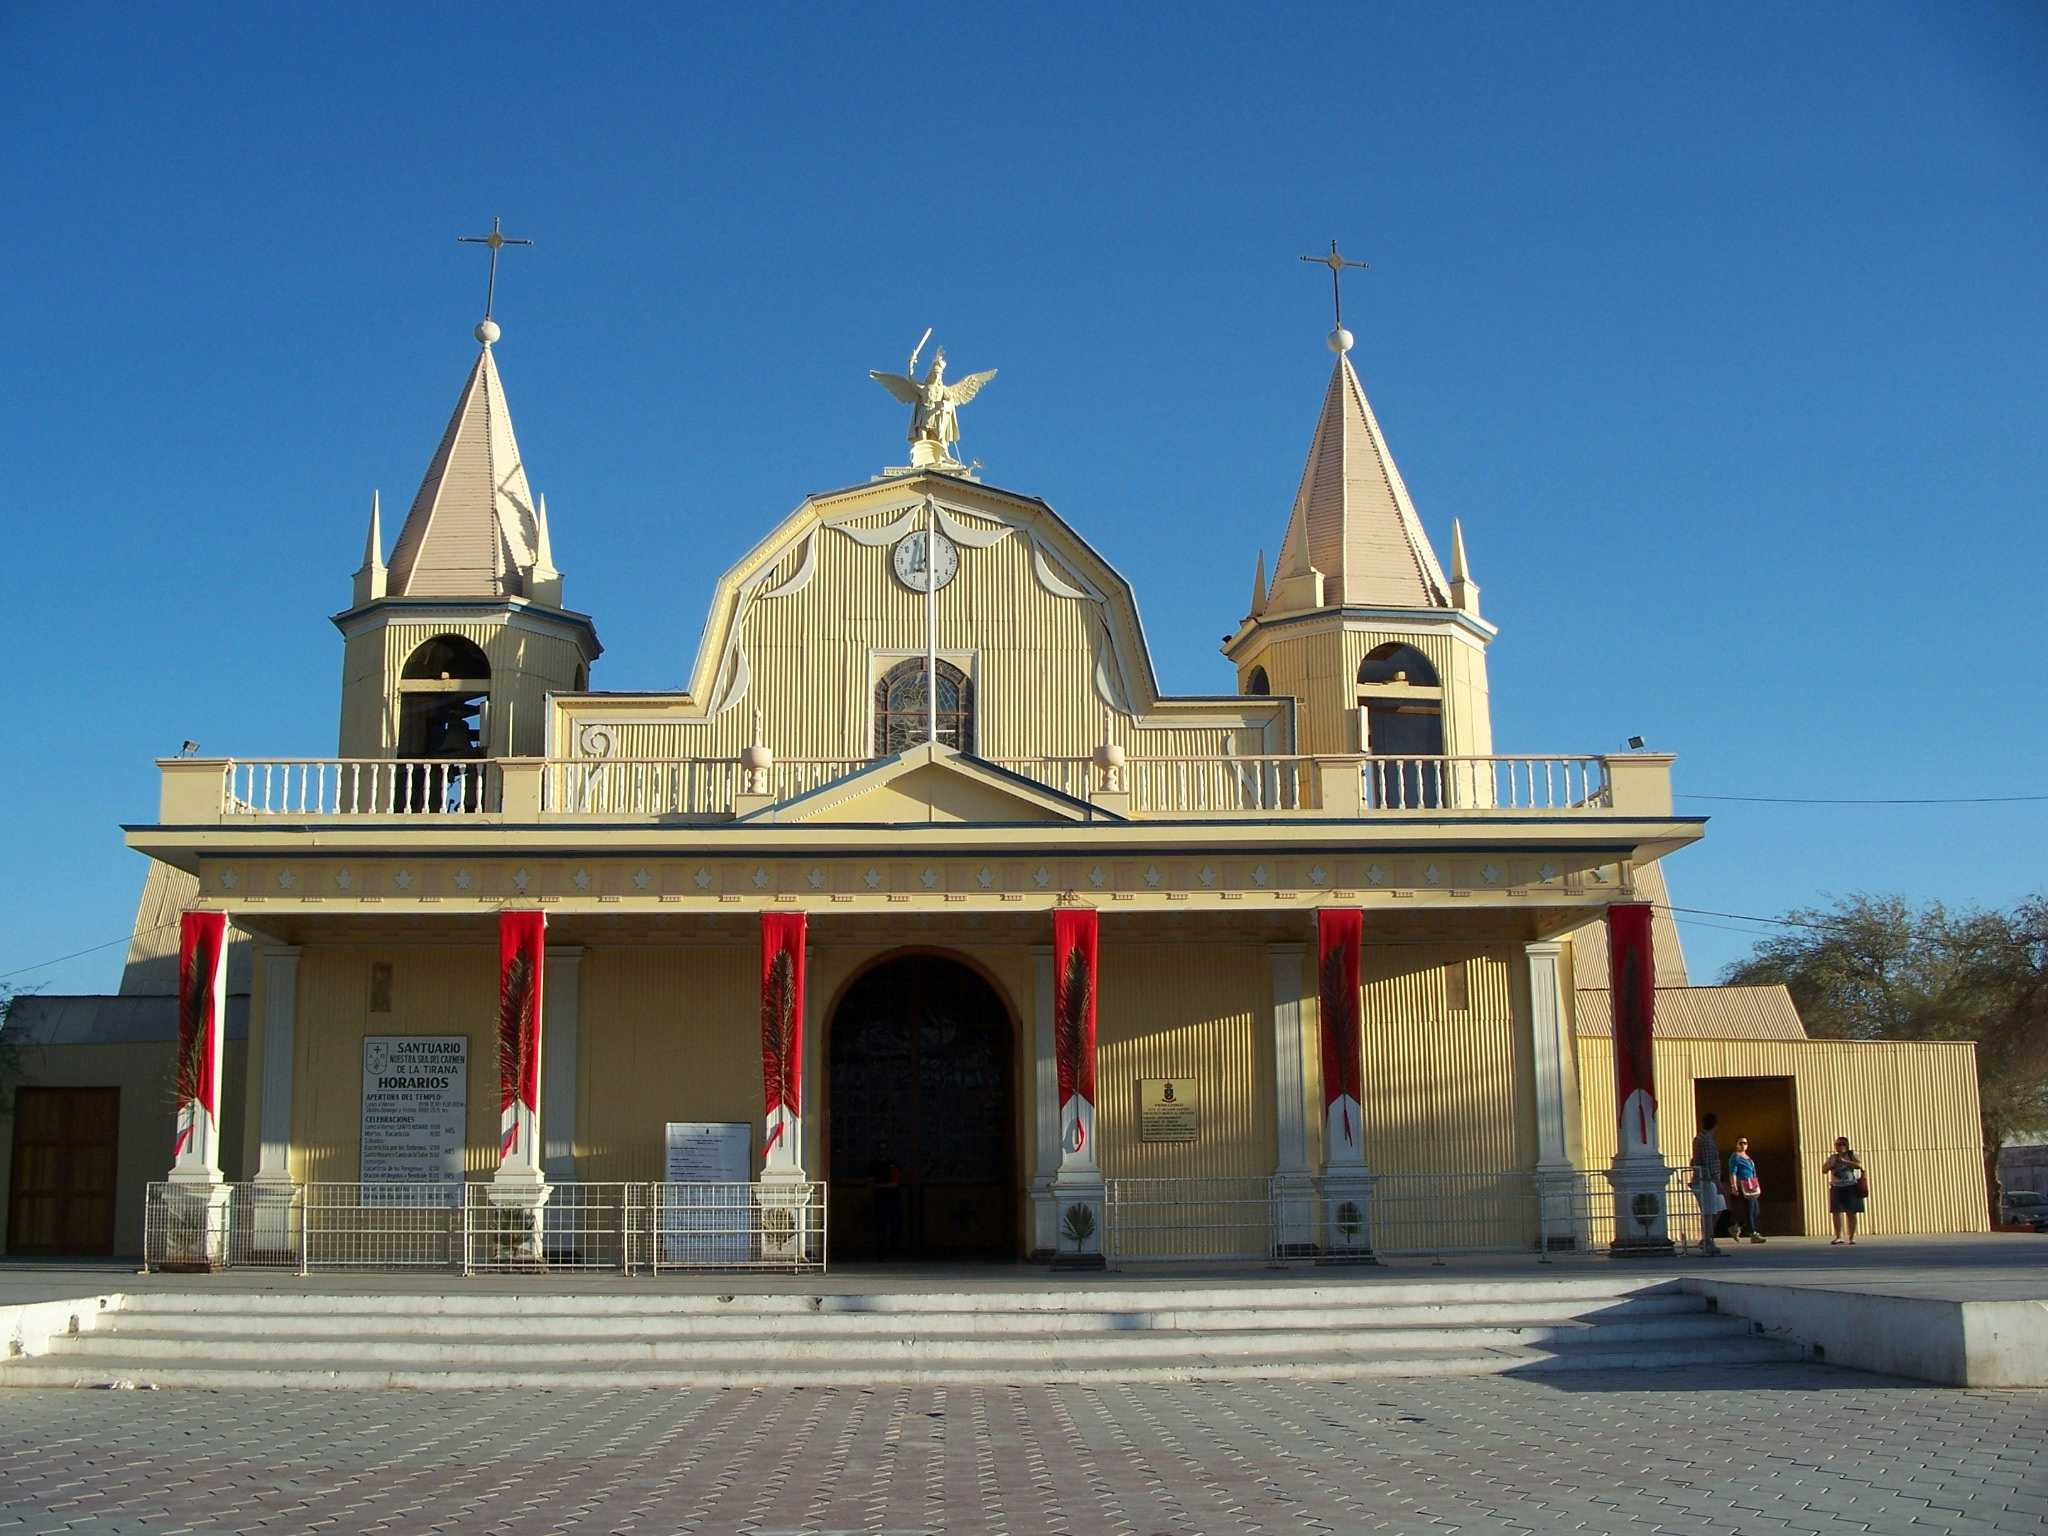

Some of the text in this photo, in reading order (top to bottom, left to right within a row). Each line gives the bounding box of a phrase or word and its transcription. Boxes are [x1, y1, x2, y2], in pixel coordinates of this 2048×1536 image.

[397, 1042, 461, 1054] SANTUARIO
[390, 1055, 416, 1064] NUESTRA
[440, 1055, 465, 1064] CARMEN
[397, 1065, 458, 1075] DE LA TIRANA
[378, 1077, 449, 1089] HORARIOS
